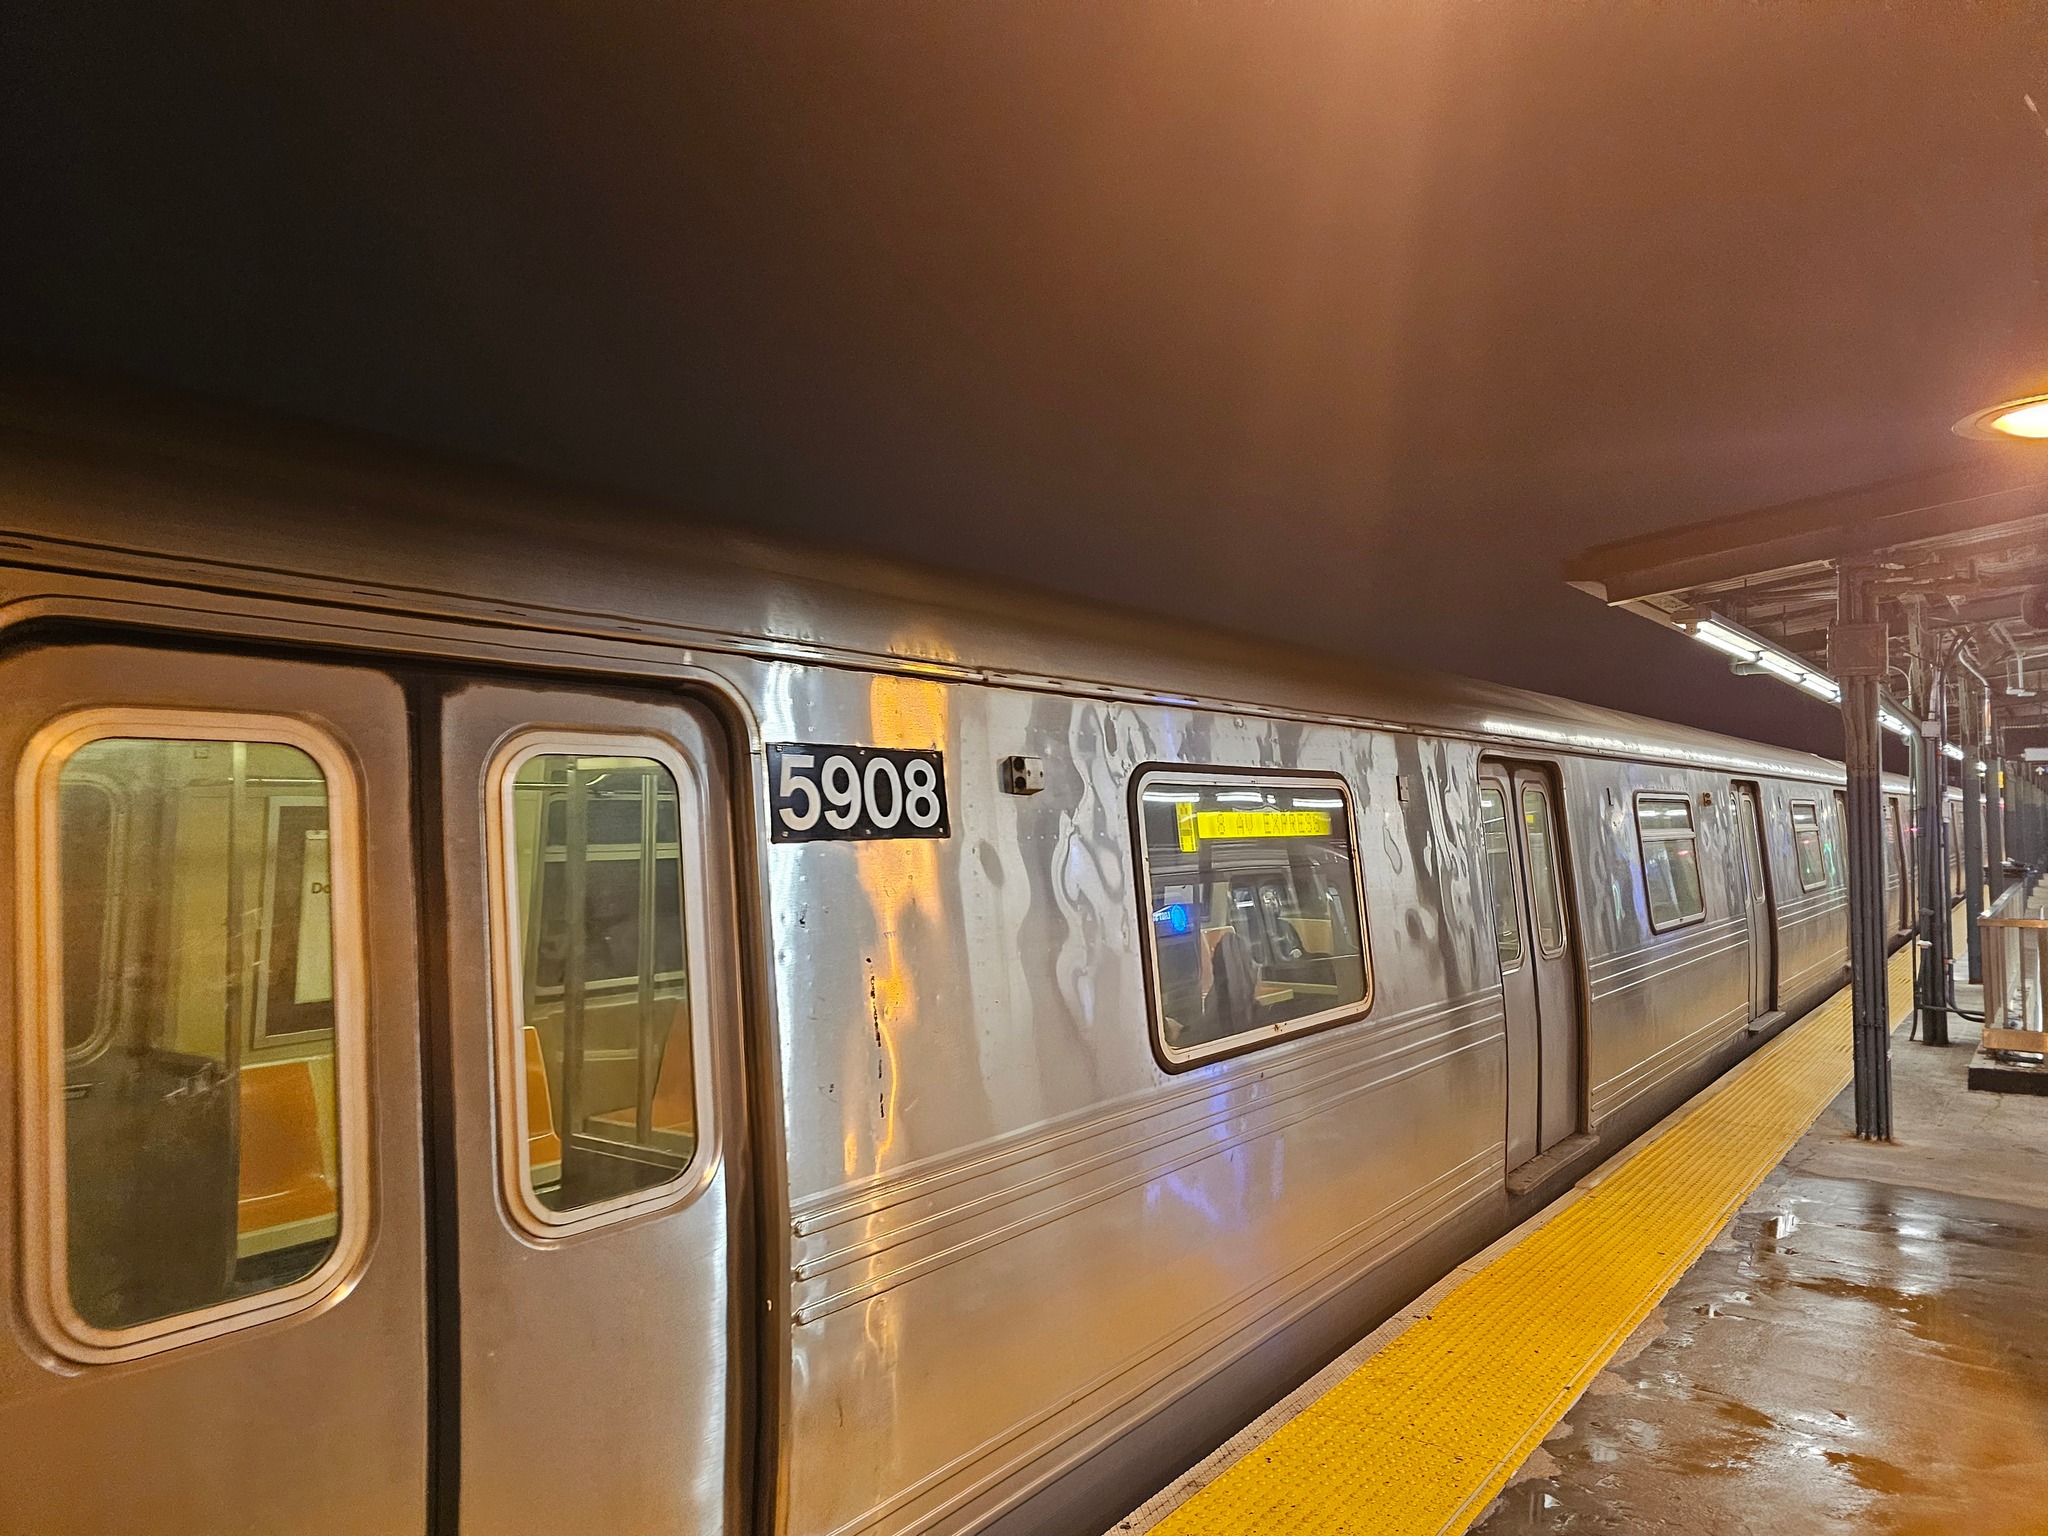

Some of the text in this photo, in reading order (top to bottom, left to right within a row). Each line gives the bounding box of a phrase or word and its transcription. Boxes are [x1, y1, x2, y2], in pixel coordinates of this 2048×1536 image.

[778, 753, 941, 831] 5908
[1216, 811, 1321, 836] 8 AV EXPRESS
